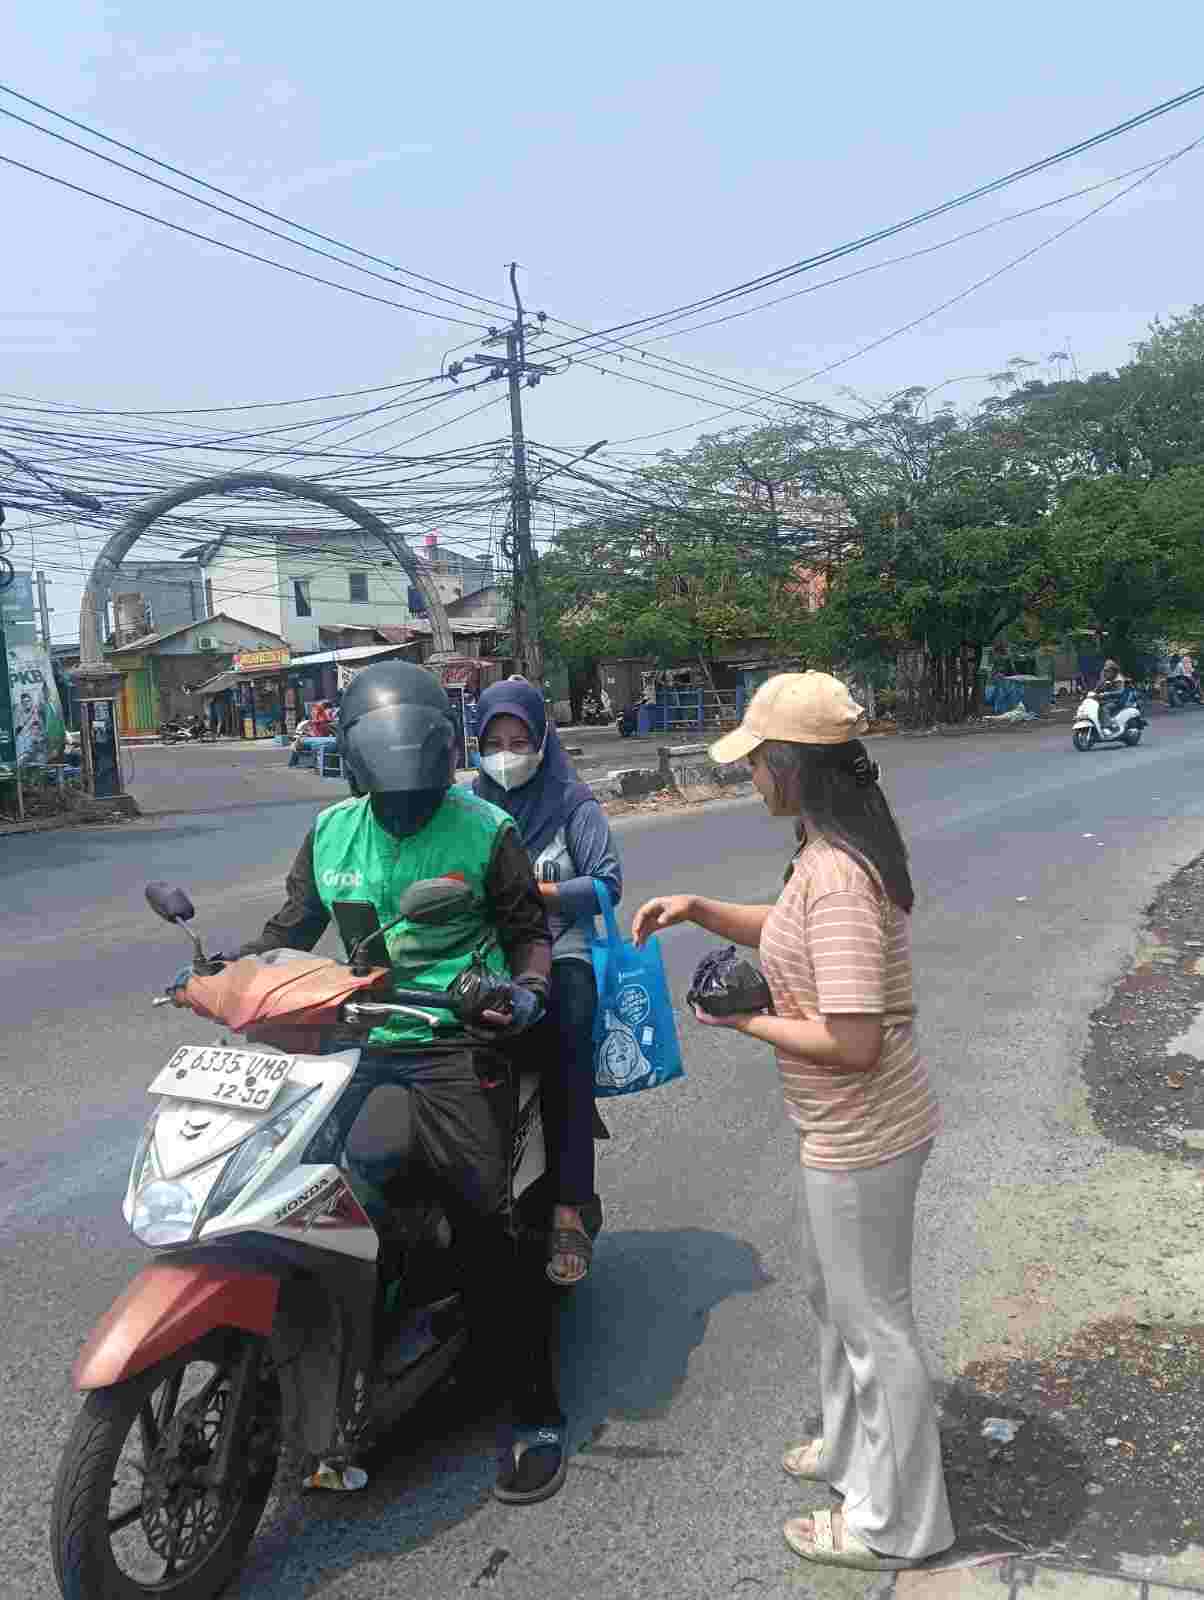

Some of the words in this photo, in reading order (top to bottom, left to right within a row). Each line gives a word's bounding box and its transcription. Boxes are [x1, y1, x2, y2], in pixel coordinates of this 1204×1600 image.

[9, 670, 43, 688] PKB
[169, 1048, 188, 1069] B
[190, 1050, 245, 1074] 6335
[272, 1176, 329, 1218] HONDA
